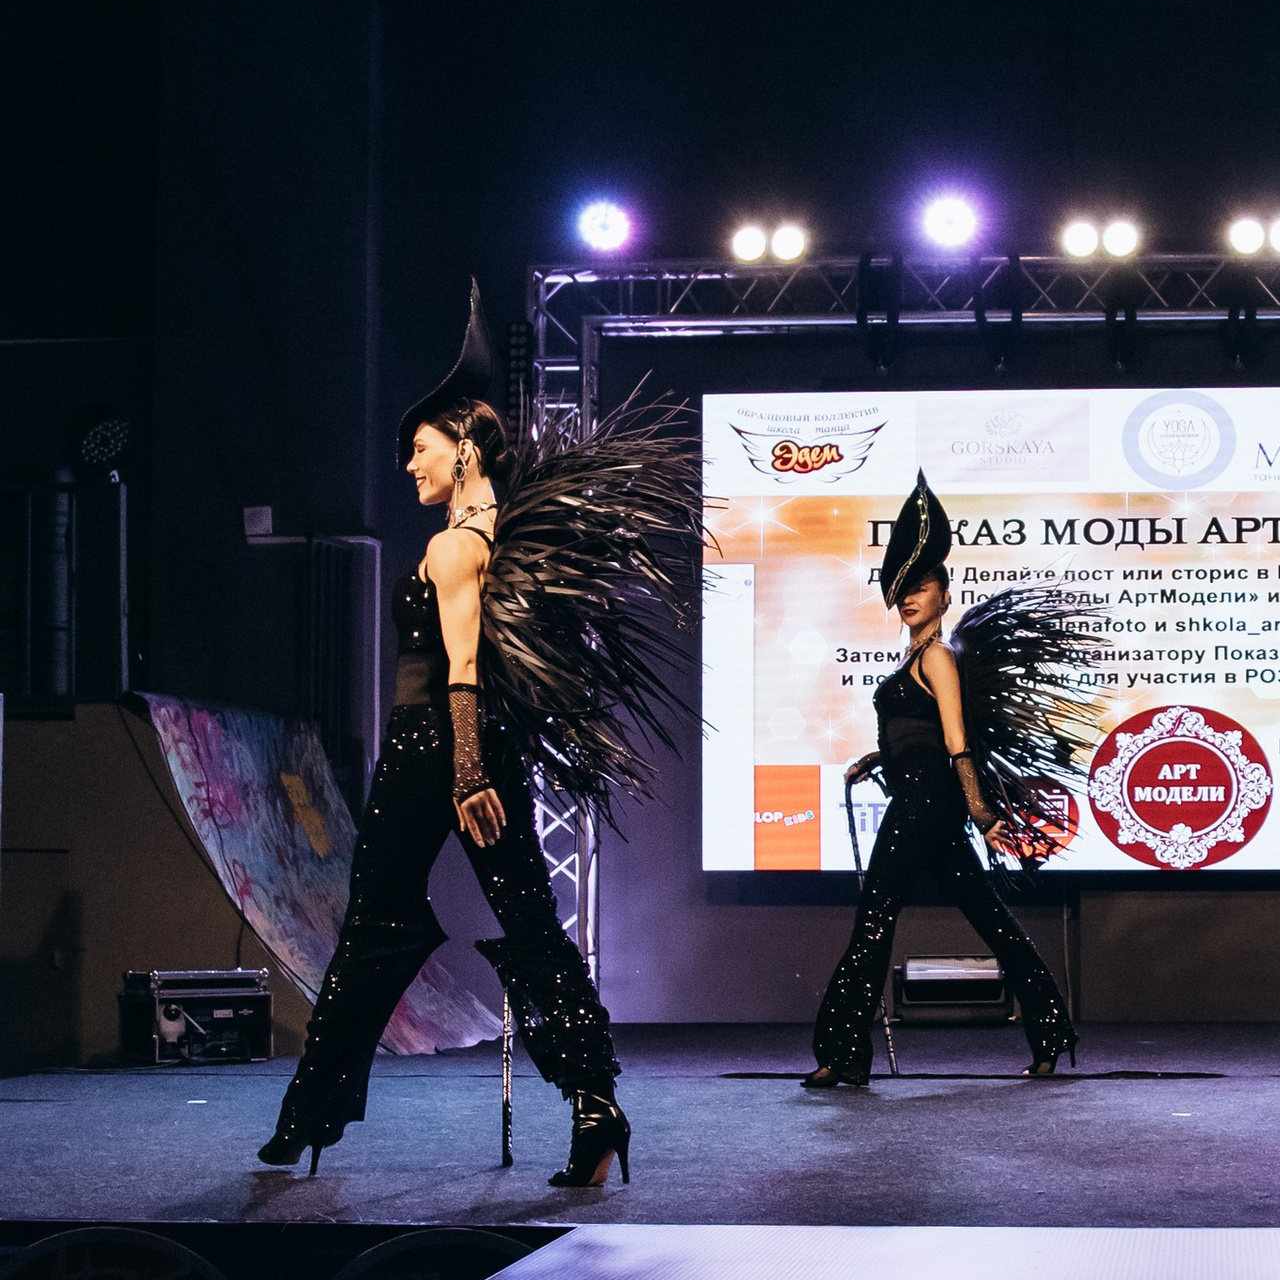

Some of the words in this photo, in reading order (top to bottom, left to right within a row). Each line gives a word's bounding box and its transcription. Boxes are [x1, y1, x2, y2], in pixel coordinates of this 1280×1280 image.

[814, 406, 880, 422] КОЛЛЕКТИВ
[767, 424, 801, 435] школа
[815, 423, 850, 435] танца
[1163, 419, 1196, 433] YOGA
[951, 440, 1055, 455] GORSKAYA
[771, 440, 844, 473] Эдем
[867, 518, 1027, 547] ПКАЗ
[1040, 517, 1188, 552] МОДЫ
[962, 566, 1056, 584] Делайте
[1065, 570, 1115, 581] пост
[1123, 570, 1163, 581] или
[1171, 568, 1249, 583] сторис
[1257, 569, 1269, 580] в
[1268, 591, 1280, 602] и
[836, 647, 901, 663] Затем
[842, 674, 854, 686] и
[1080, 672, 1119, 687] для
[1127, 672, 1216, 688] участия
[1225, 673, 1237, 684] в
[1157, 764, 1201, 780] АРТ
[1134, 786, 1226, 805] МОДЕЛИ
